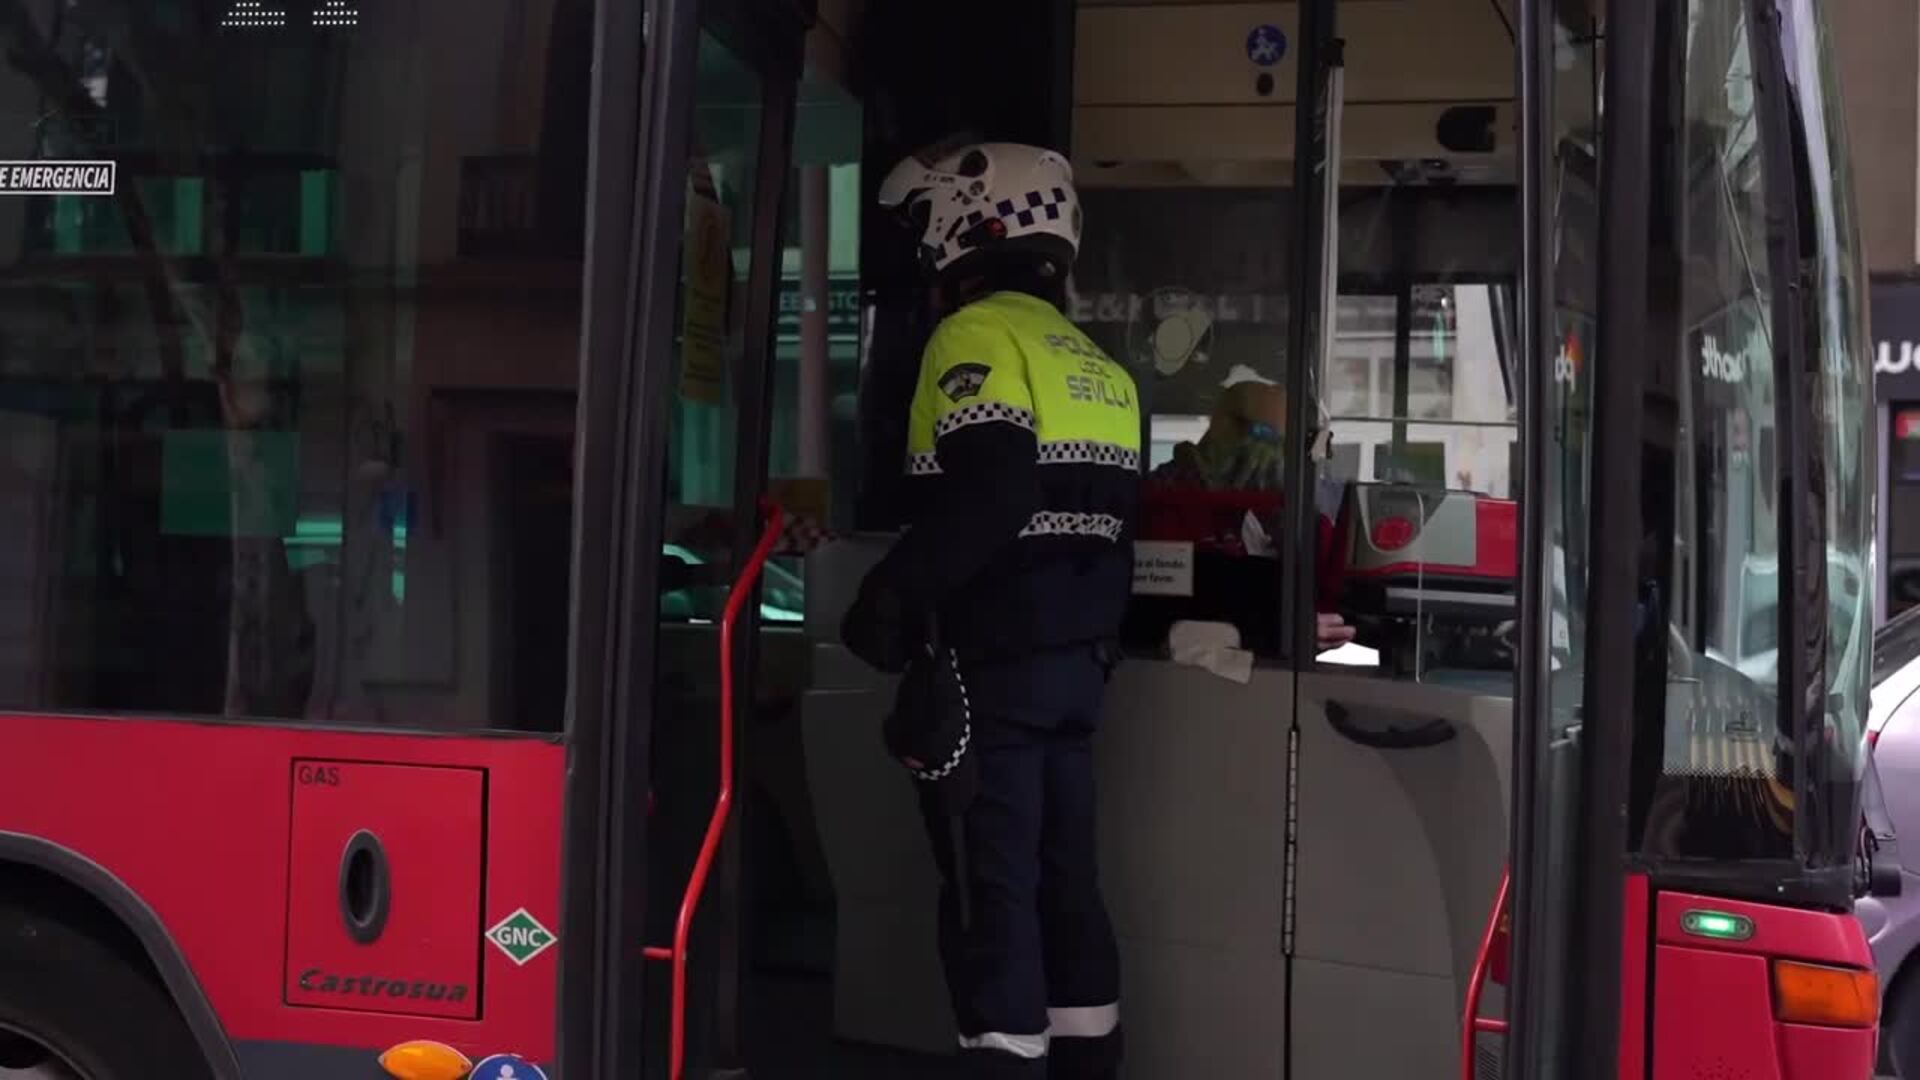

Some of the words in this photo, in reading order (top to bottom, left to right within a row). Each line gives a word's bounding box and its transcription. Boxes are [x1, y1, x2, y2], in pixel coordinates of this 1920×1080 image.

[10, 166, 110, 189] EMERGENCIA
[298, 765, 340, 786] GAS
[495, 926, 542, 948] GNC
[298, 967, 470, 1002] Castrosua
